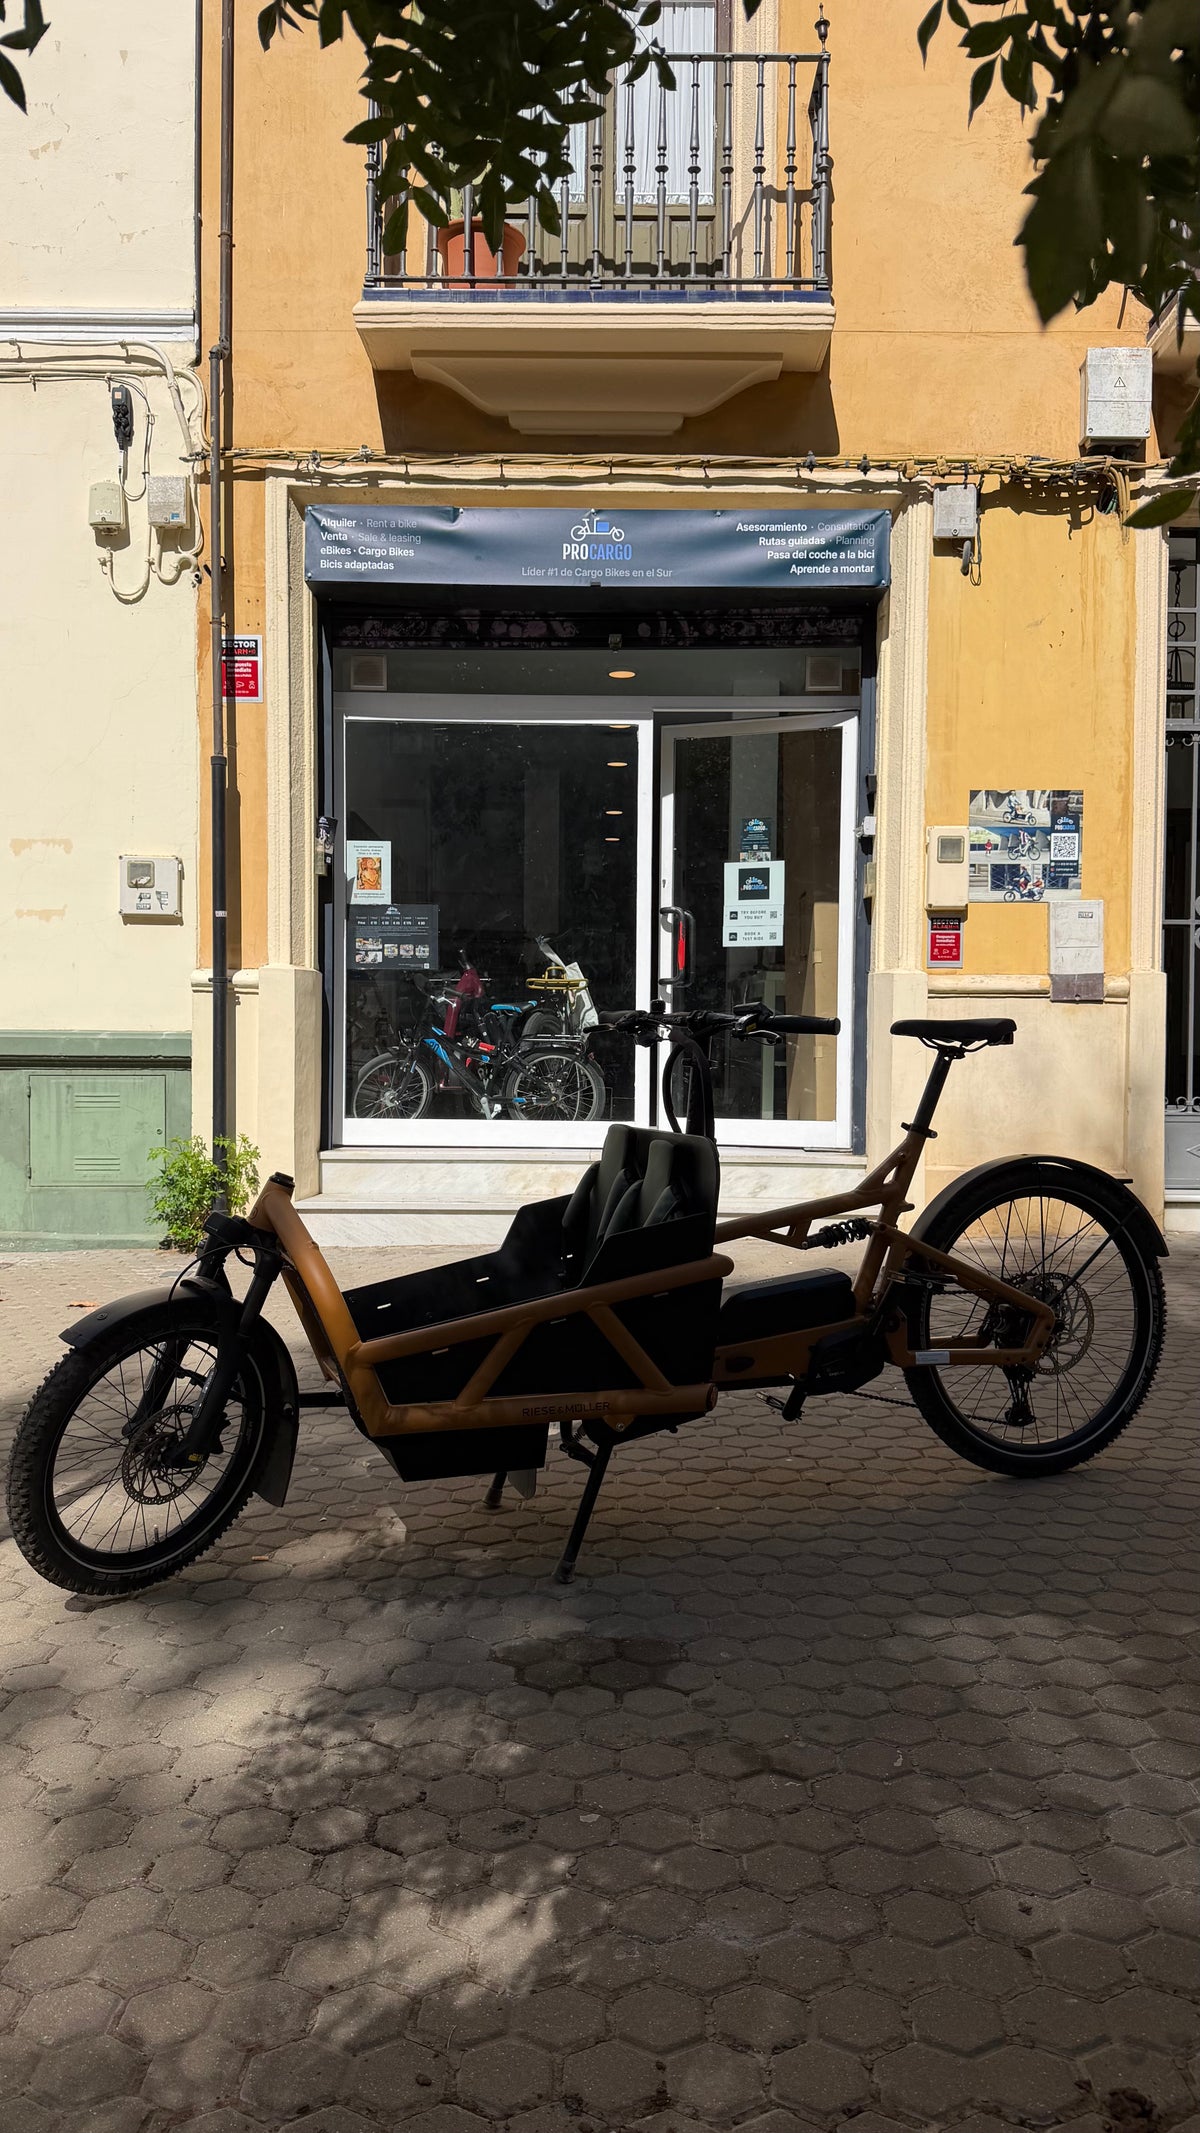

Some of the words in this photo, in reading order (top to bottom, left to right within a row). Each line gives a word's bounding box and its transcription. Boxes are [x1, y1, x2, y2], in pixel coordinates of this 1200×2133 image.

[320, 518, 357, 529] Alquiler
[366, 518, 388, 528] Rent
[389, 520, 396, 528] a
[398, 518, 417, 528] bike
[735, 522, 808, 532] Asesoramiento
[817, 521, 876, 531] Consultation
[320, 531, 348, 541] Venta
[358, 532, 378, 542] Sale
[379, 533, 387, 542] &
[388, 533, 421, 545] leasing
[758, 536, 787, 546] Rutas
[787, 536, 826, 547] guiadas
[835, 535, 875, 547] Planning
[320, 545, 352, 555] eBikes
[358, 546, 387, 558] Cargo
[388, 546, 415, 557] Bikes
[562, 543, 633, 561] PROCARGO
[767, 550, 791, 560] Pasa
[792, 550, 807, 559] del
[808, 550, 838, 559] coche
[847, 550, 856, 559] la
[857, 549, 875, 559] bici
[320, 559, 343, 569] Bicis
[344, 560, 395, 571] adaptadas
[789, 564, 831, 575] Aprende
[832, 566, 839, 574] a
[840, 564, 875, 574] montar
[521, 566, 546, 577] Líder
[547, 567, 558, 577] #1
[560, 567, 573, 577] de
[574, 568, 604, 579] Cargo
[605, 568, 630, 577] Bikes
[646, 568, 655, 578] el
[656, 568, 673, 578] Sur
[222, 640, 256, 648] SECTOR
[522, 1406, 556, 1417] RIESE
